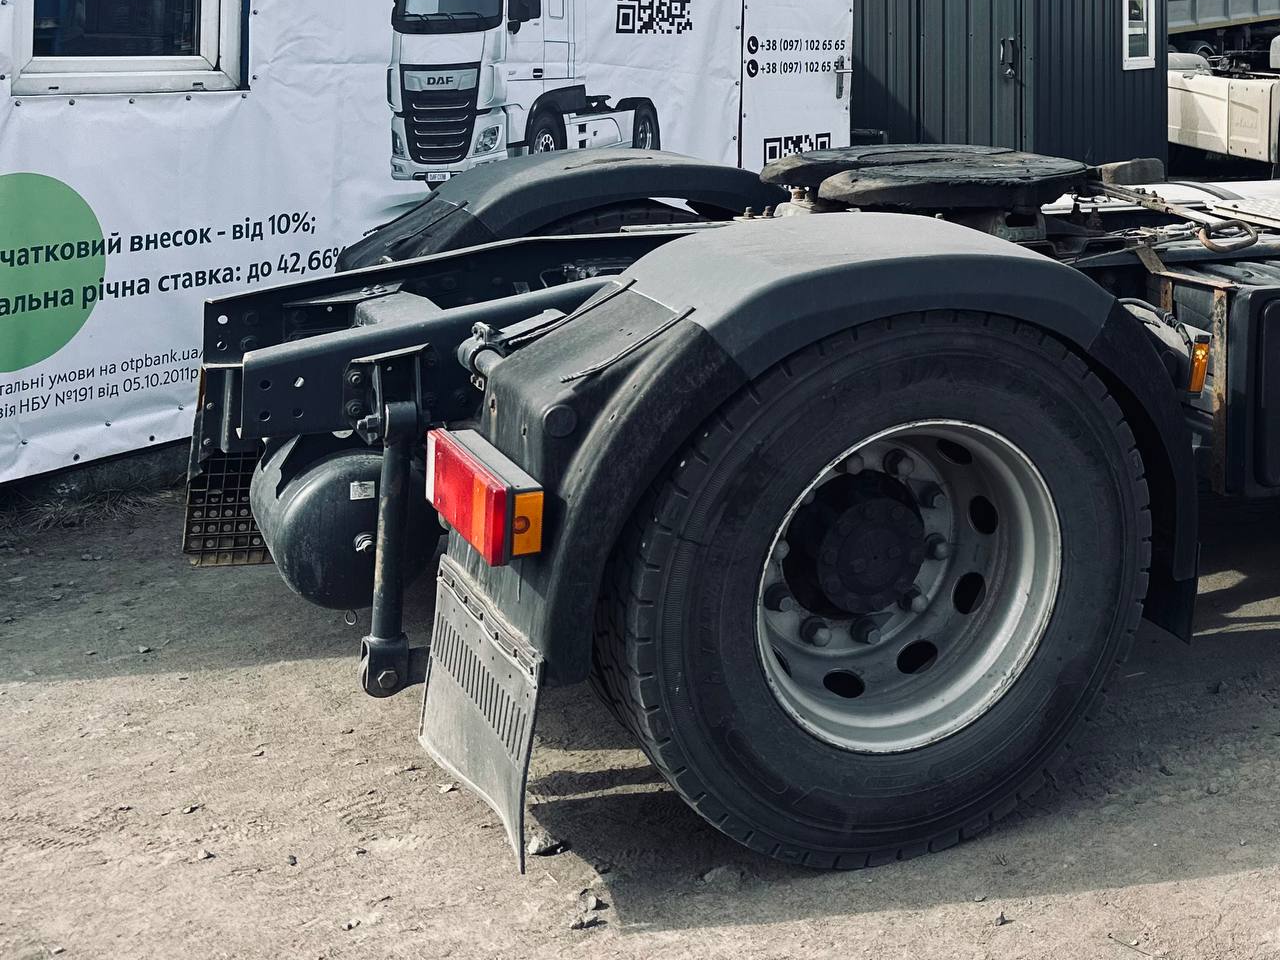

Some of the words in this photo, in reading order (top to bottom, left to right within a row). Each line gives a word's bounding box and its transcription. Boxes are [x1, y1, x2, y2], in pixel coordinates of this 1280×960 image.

[760, 39, 777, 51] +38
[779, 38, 802, 52] (097)
[805, 39, 820, 51] 102
[822, 39, 832, 51] 65
[834, 39, 845, 51] 65
[426, 76, 454, 85] DAF
[760, 62, 777, 74] +38
[779, 60, 802, 74] (097)
[805, 61, 819, 73] 102
[821, 61, 831, 72] 65
[130, 227, 212, 252] внесок
[232, 216, 263, 242] від
[268, 211, 316, 235] 10%;
[82, 277, 150, 310] річна
[158, 266, 241, 292] ставка:
[247, 261, 272, 283] до
[48, 368, 95, 390] умови
[100, 363, 117, 377] на
[19, 394, 51, 414] НБУ
[55, 386, 94, 407] №191
[98, 383, 119, 398] від
